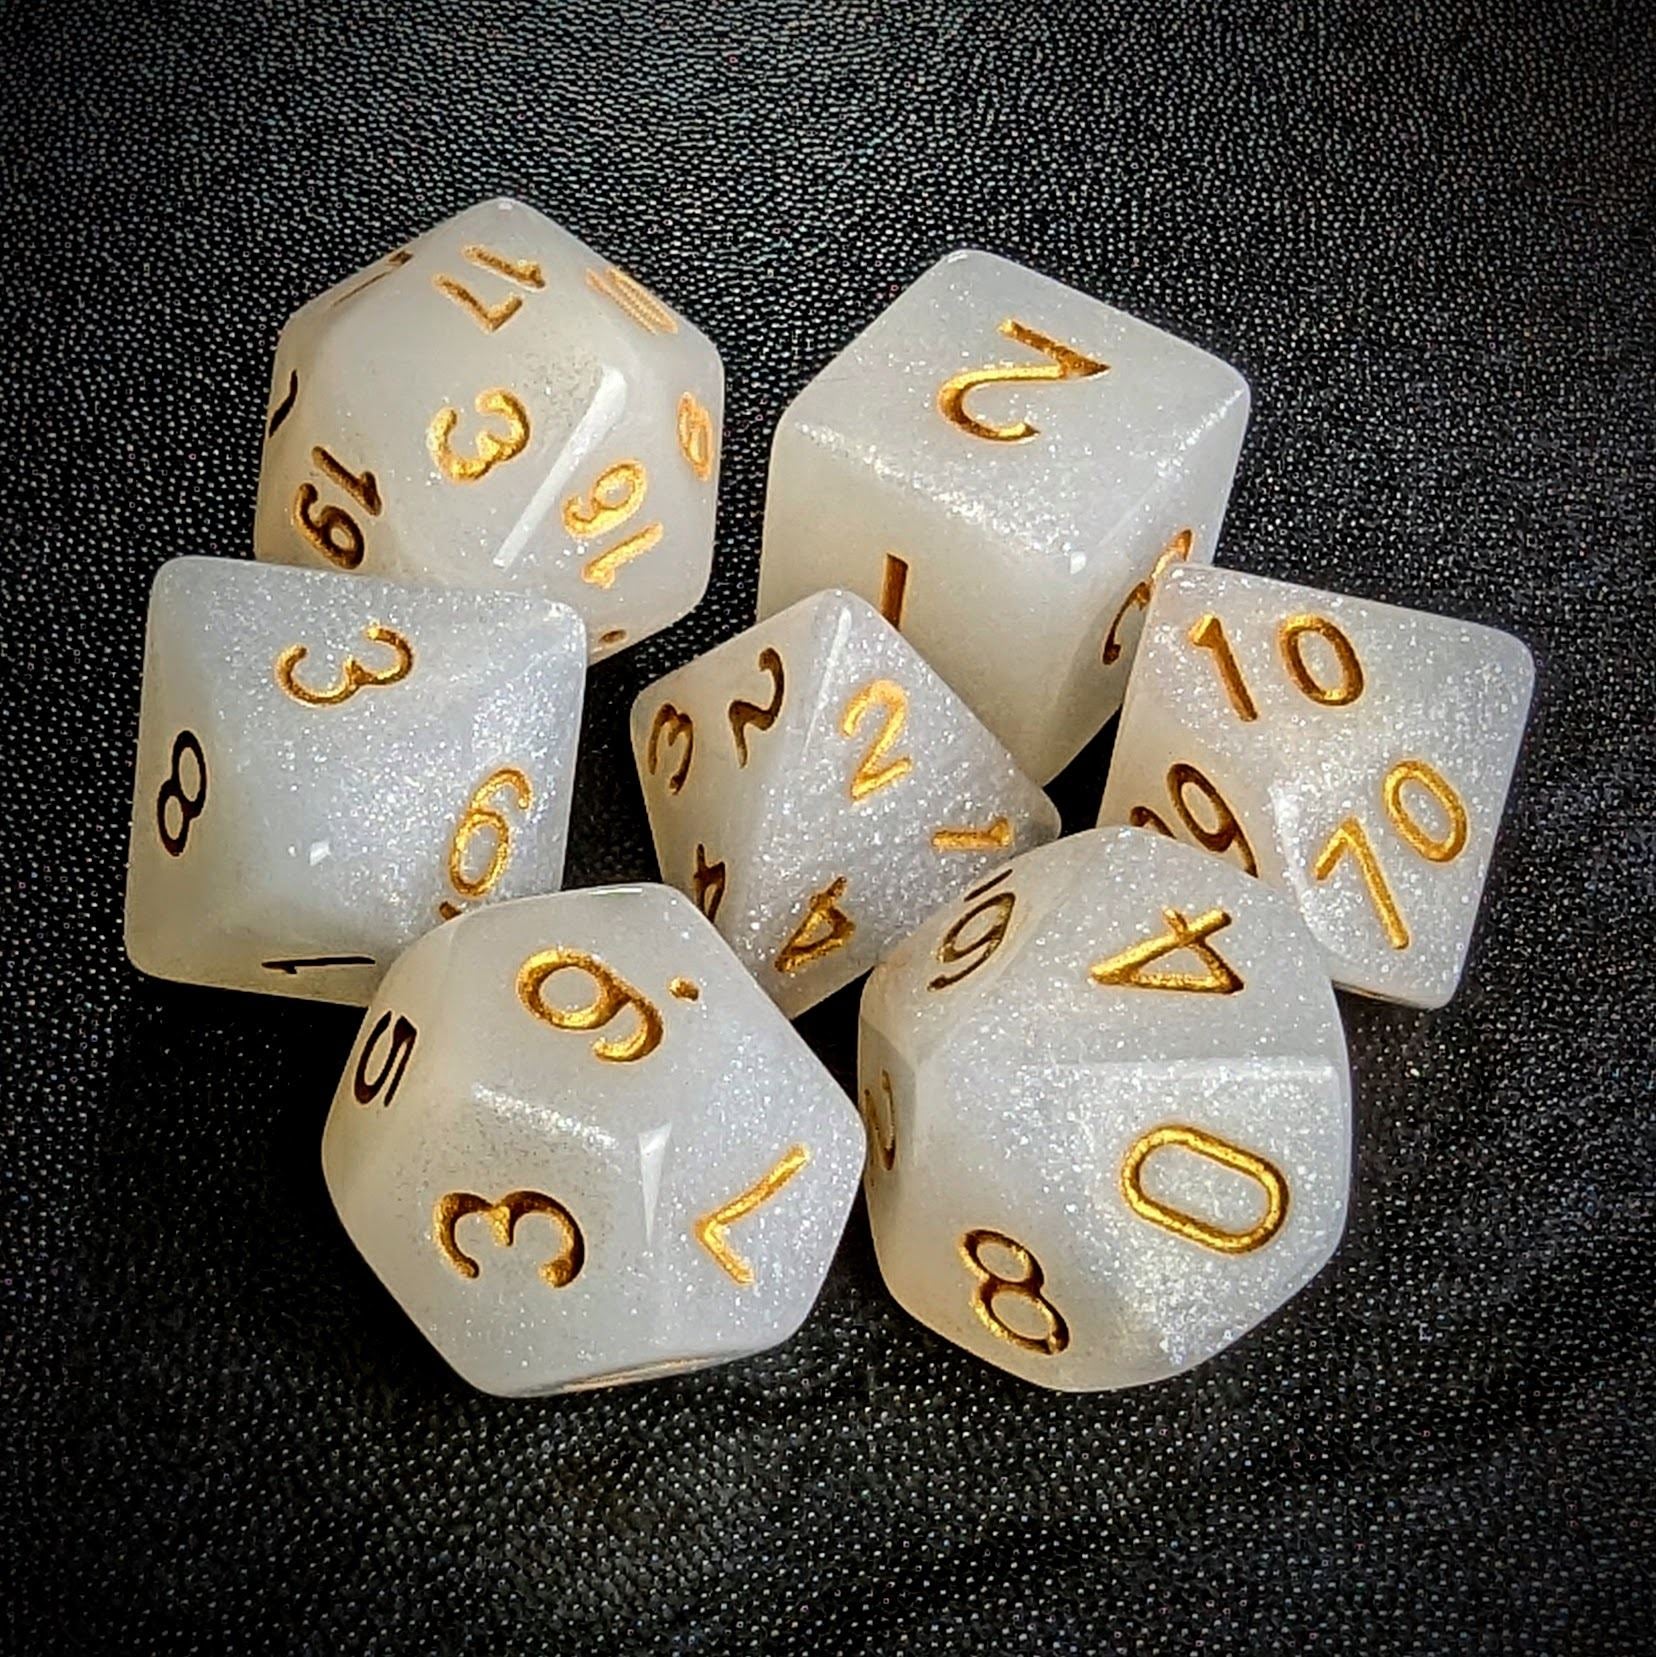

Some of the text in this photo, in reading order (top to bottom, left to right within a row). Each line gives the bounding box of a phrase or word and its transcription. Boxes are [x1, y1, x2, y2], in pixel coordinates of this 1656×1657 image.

[430, 244, 546, 334] 17
[426, 387, 532, 484] 3
[937, 316, 1111, 444] 2
[293, 445, 382, 570] 19
[562, 460, 664, 589] 16
[274, 622, 415, 707] 3
[728, 646, 786, 769] 2
[1187, 611, 1367, 723] 10
[157, 729, 207, 858] 8
[647, 702, 694, 795] 3
[841, 678, 914, 804] 2
[930, 815, 1016, 852] 1
[1313, 760, 1470, 950] 70
[260, 954, 377, 977] 1
[773, 874, 857, 975] 4
[1089, 905, 1246, 997] 4
[353, 1009, 418, 1108] 5
[430, 1189, 588, 1290] 3
[693, 1143, 813, 1287] 7
[1118, 1121, 1294, 1257] 0
[957, 1227, 1073, 1358] 8
